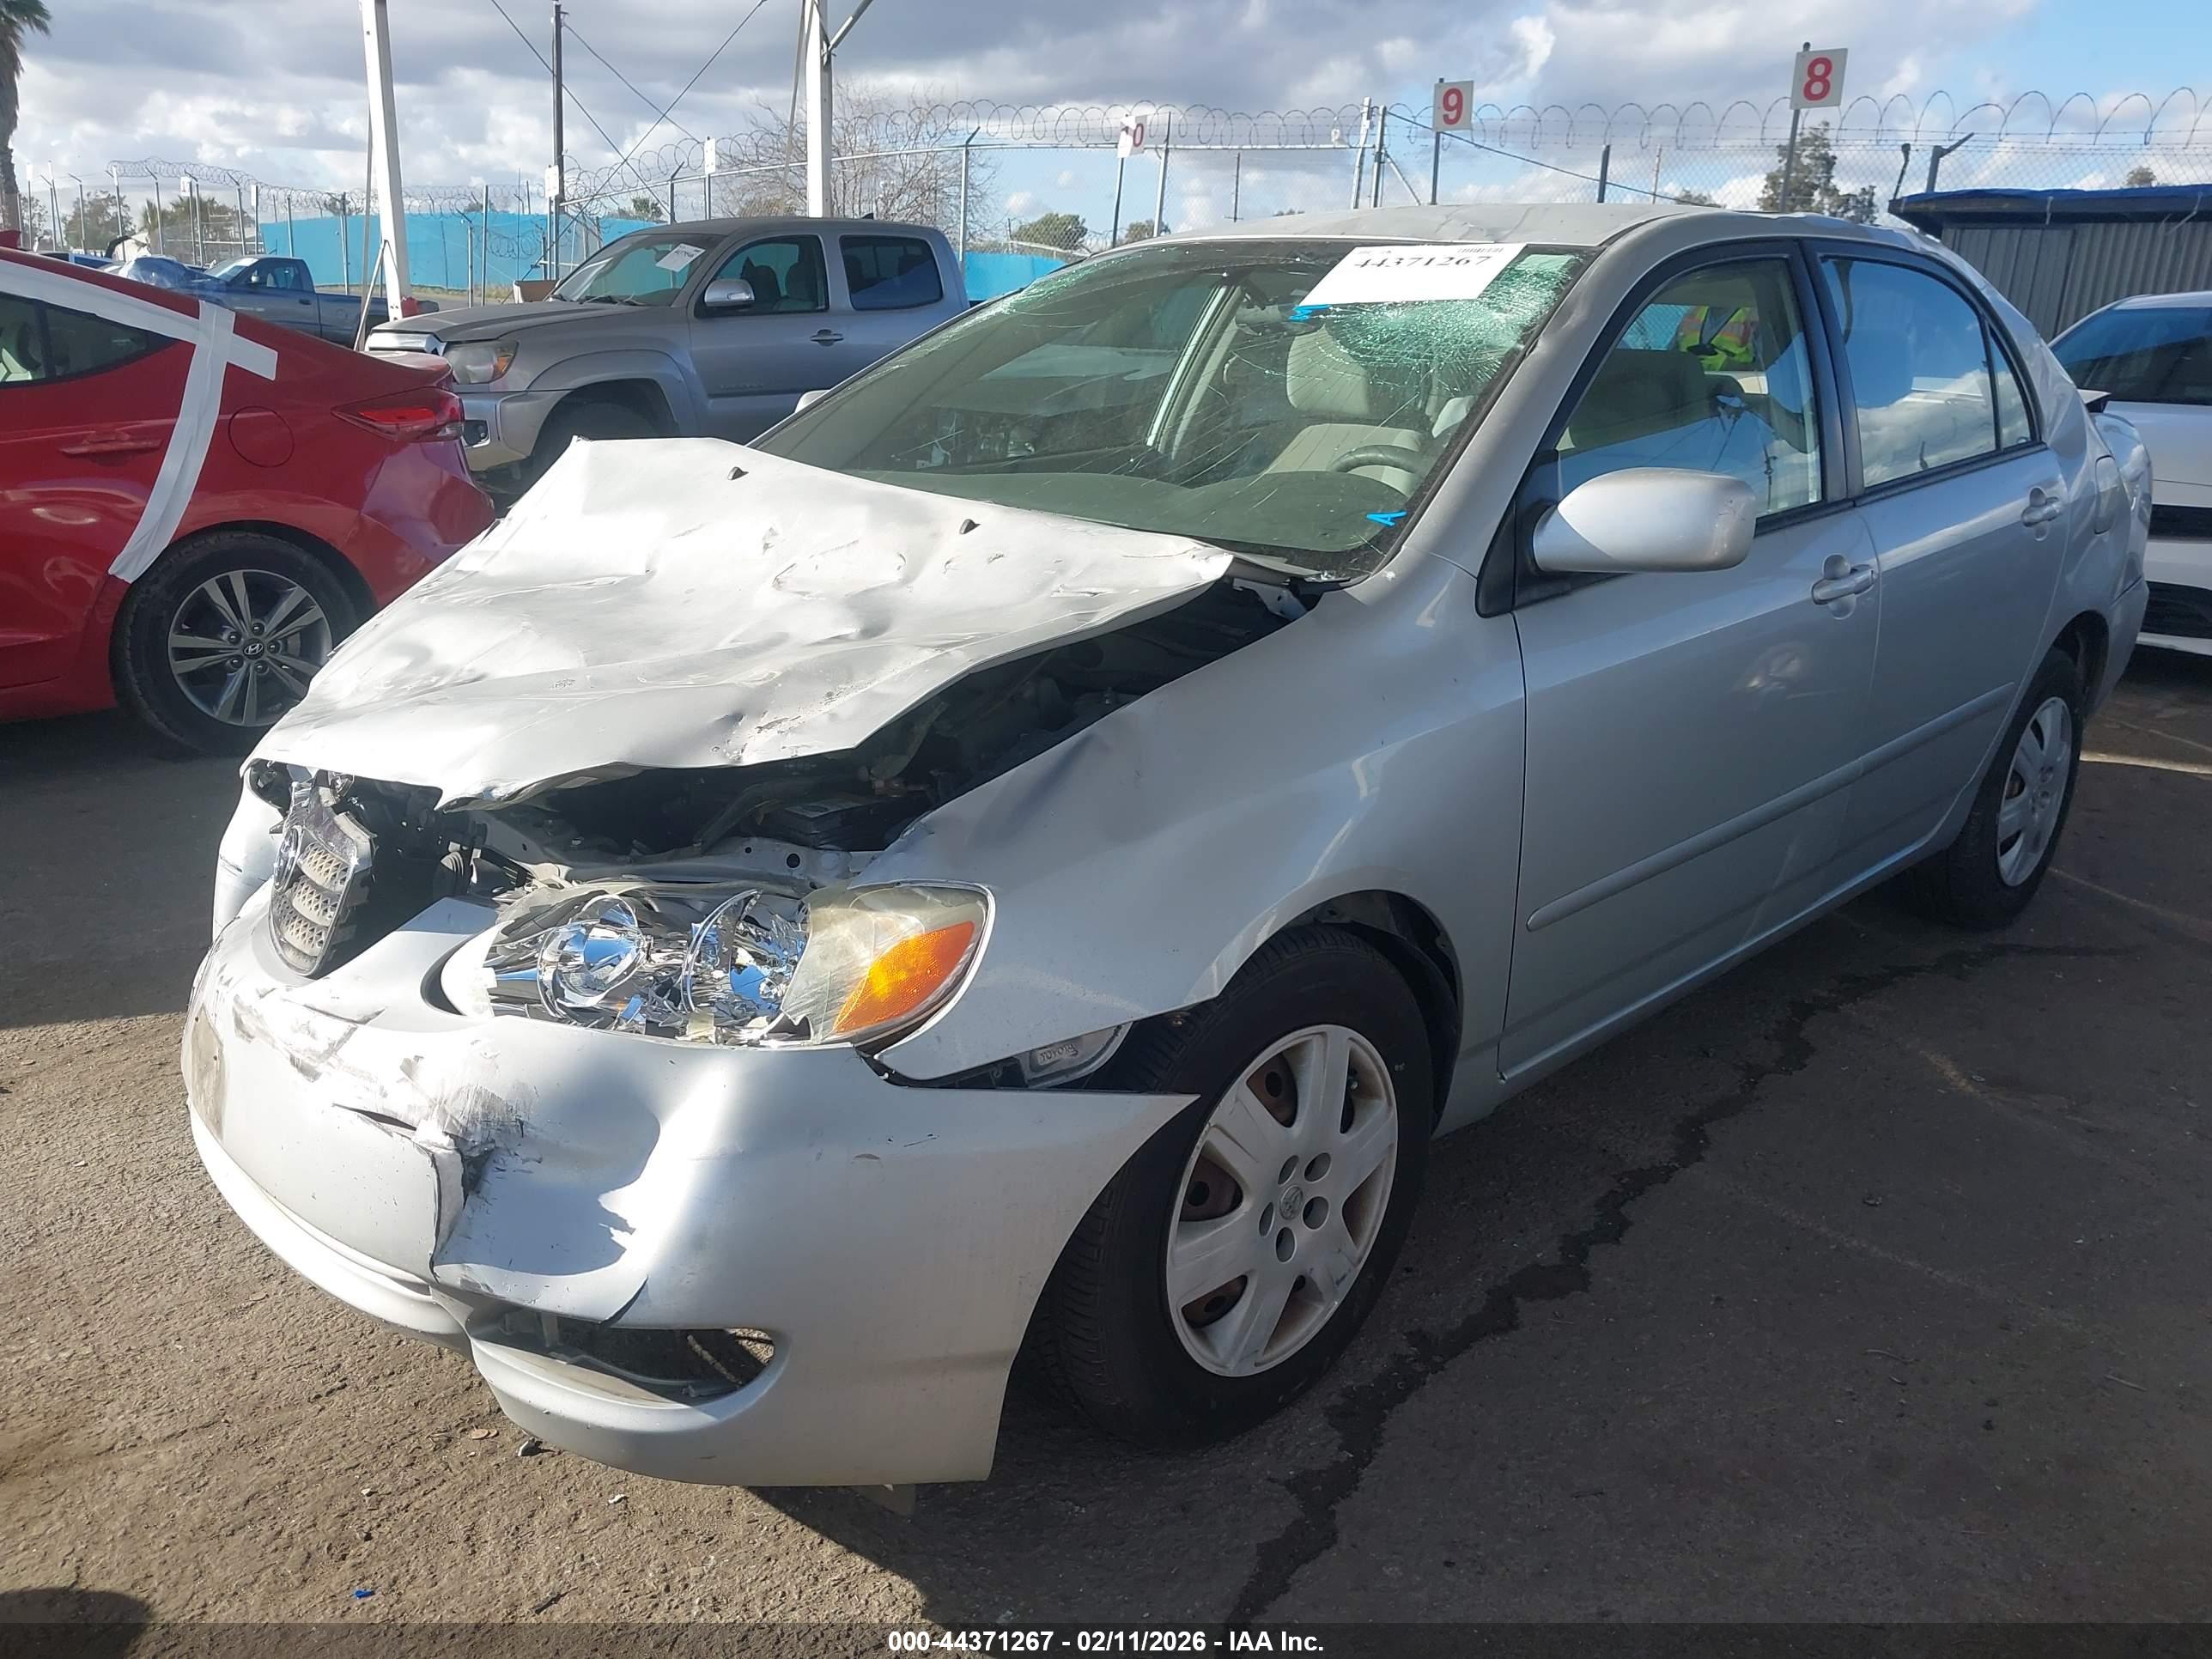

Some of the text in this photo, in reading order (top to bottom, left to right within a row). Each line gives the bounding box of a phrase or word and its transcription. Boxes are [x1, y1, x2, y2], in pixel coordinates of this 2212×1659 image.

[1802, 57, 1832, 101] 8
[1443, 88, 1463, 125] 9
[1354, 256, 1492, 268] 44371267
